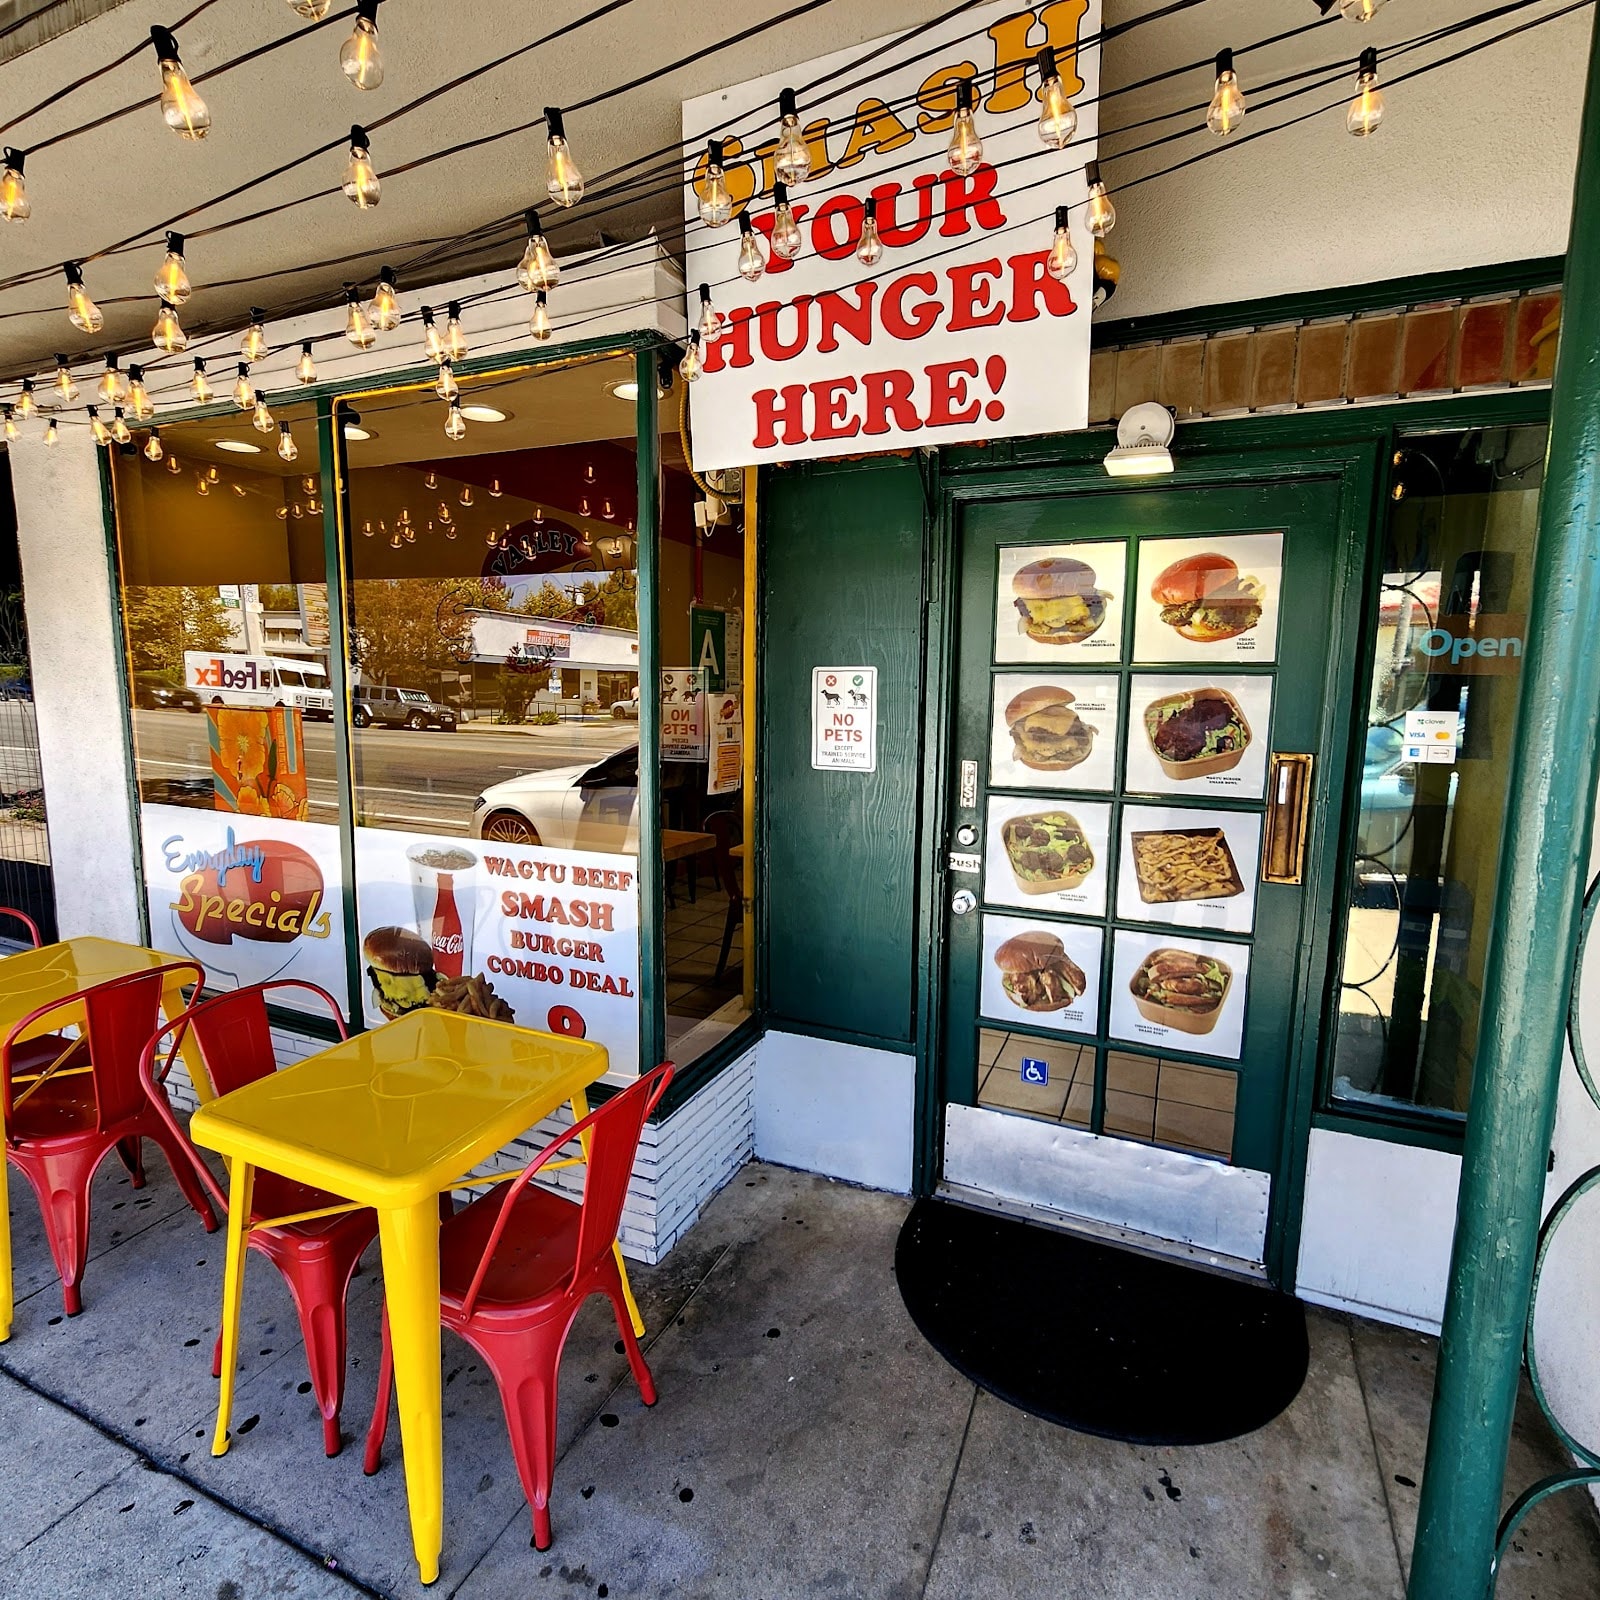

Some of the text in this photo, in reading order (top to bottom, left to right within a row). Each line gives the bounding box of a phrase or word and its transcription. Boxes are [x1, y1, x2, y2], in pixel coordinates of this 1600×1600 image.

[752, 162, 1006, 274] YOUR
[703, 249, 1077, 373] HUNGER
[752, 354, 1006, 448] HERE!
[698, 629, 719, 675] A
[1419, 628, 1523, 665] Open
[824, 729, 863, 742] PETS
[833, 713, 854, 726] NO
[161, 825, 266, 887] Everyday
[483, 855, 633, 891] WAGYU BEEF
[949, 857, 981, 869] Push
[169, 874, 332, 939] Specials
[501, 890, 615, 932] SMASH
[510, 929, 606, 963] BURGER
[487, 954, 634, 997] COMBO DEAL
